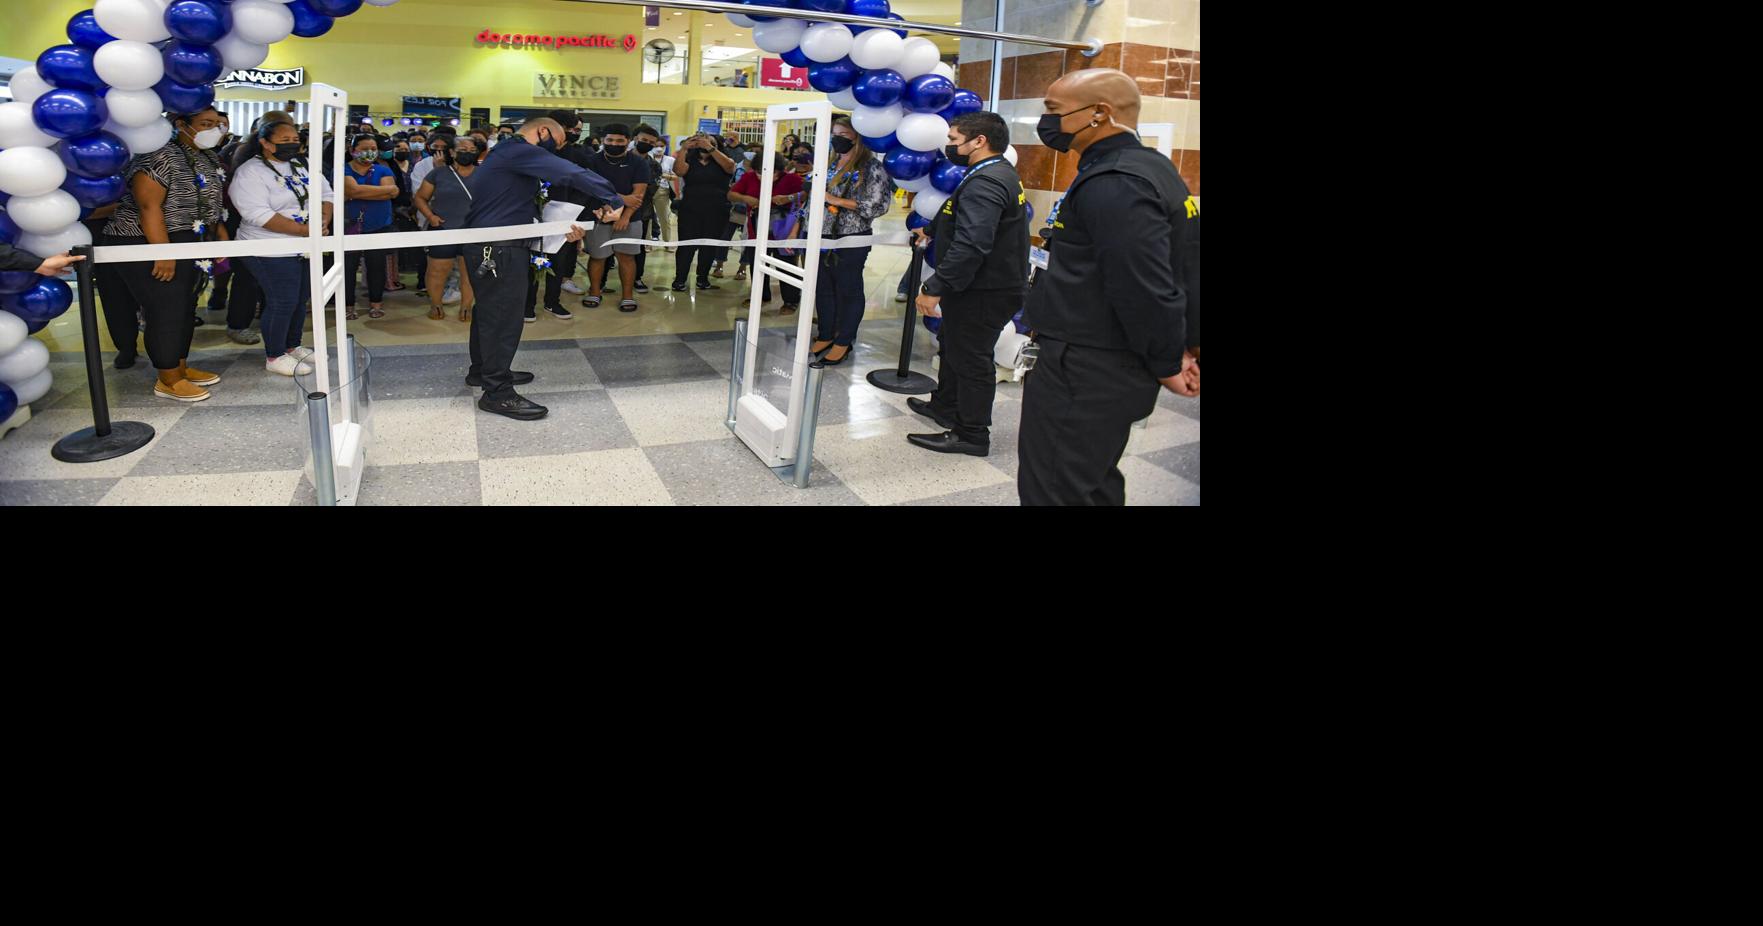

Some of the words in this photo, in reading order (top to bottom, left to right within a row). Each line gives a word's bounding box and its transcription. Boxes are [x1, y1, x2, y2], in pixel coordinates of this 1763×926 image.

[477, 28, 553, 45] docomo
[556, 34, 617, 49] pacific
[227, 69, 300, 85] NNABON
[538, 74, 619, 92] VINCE
